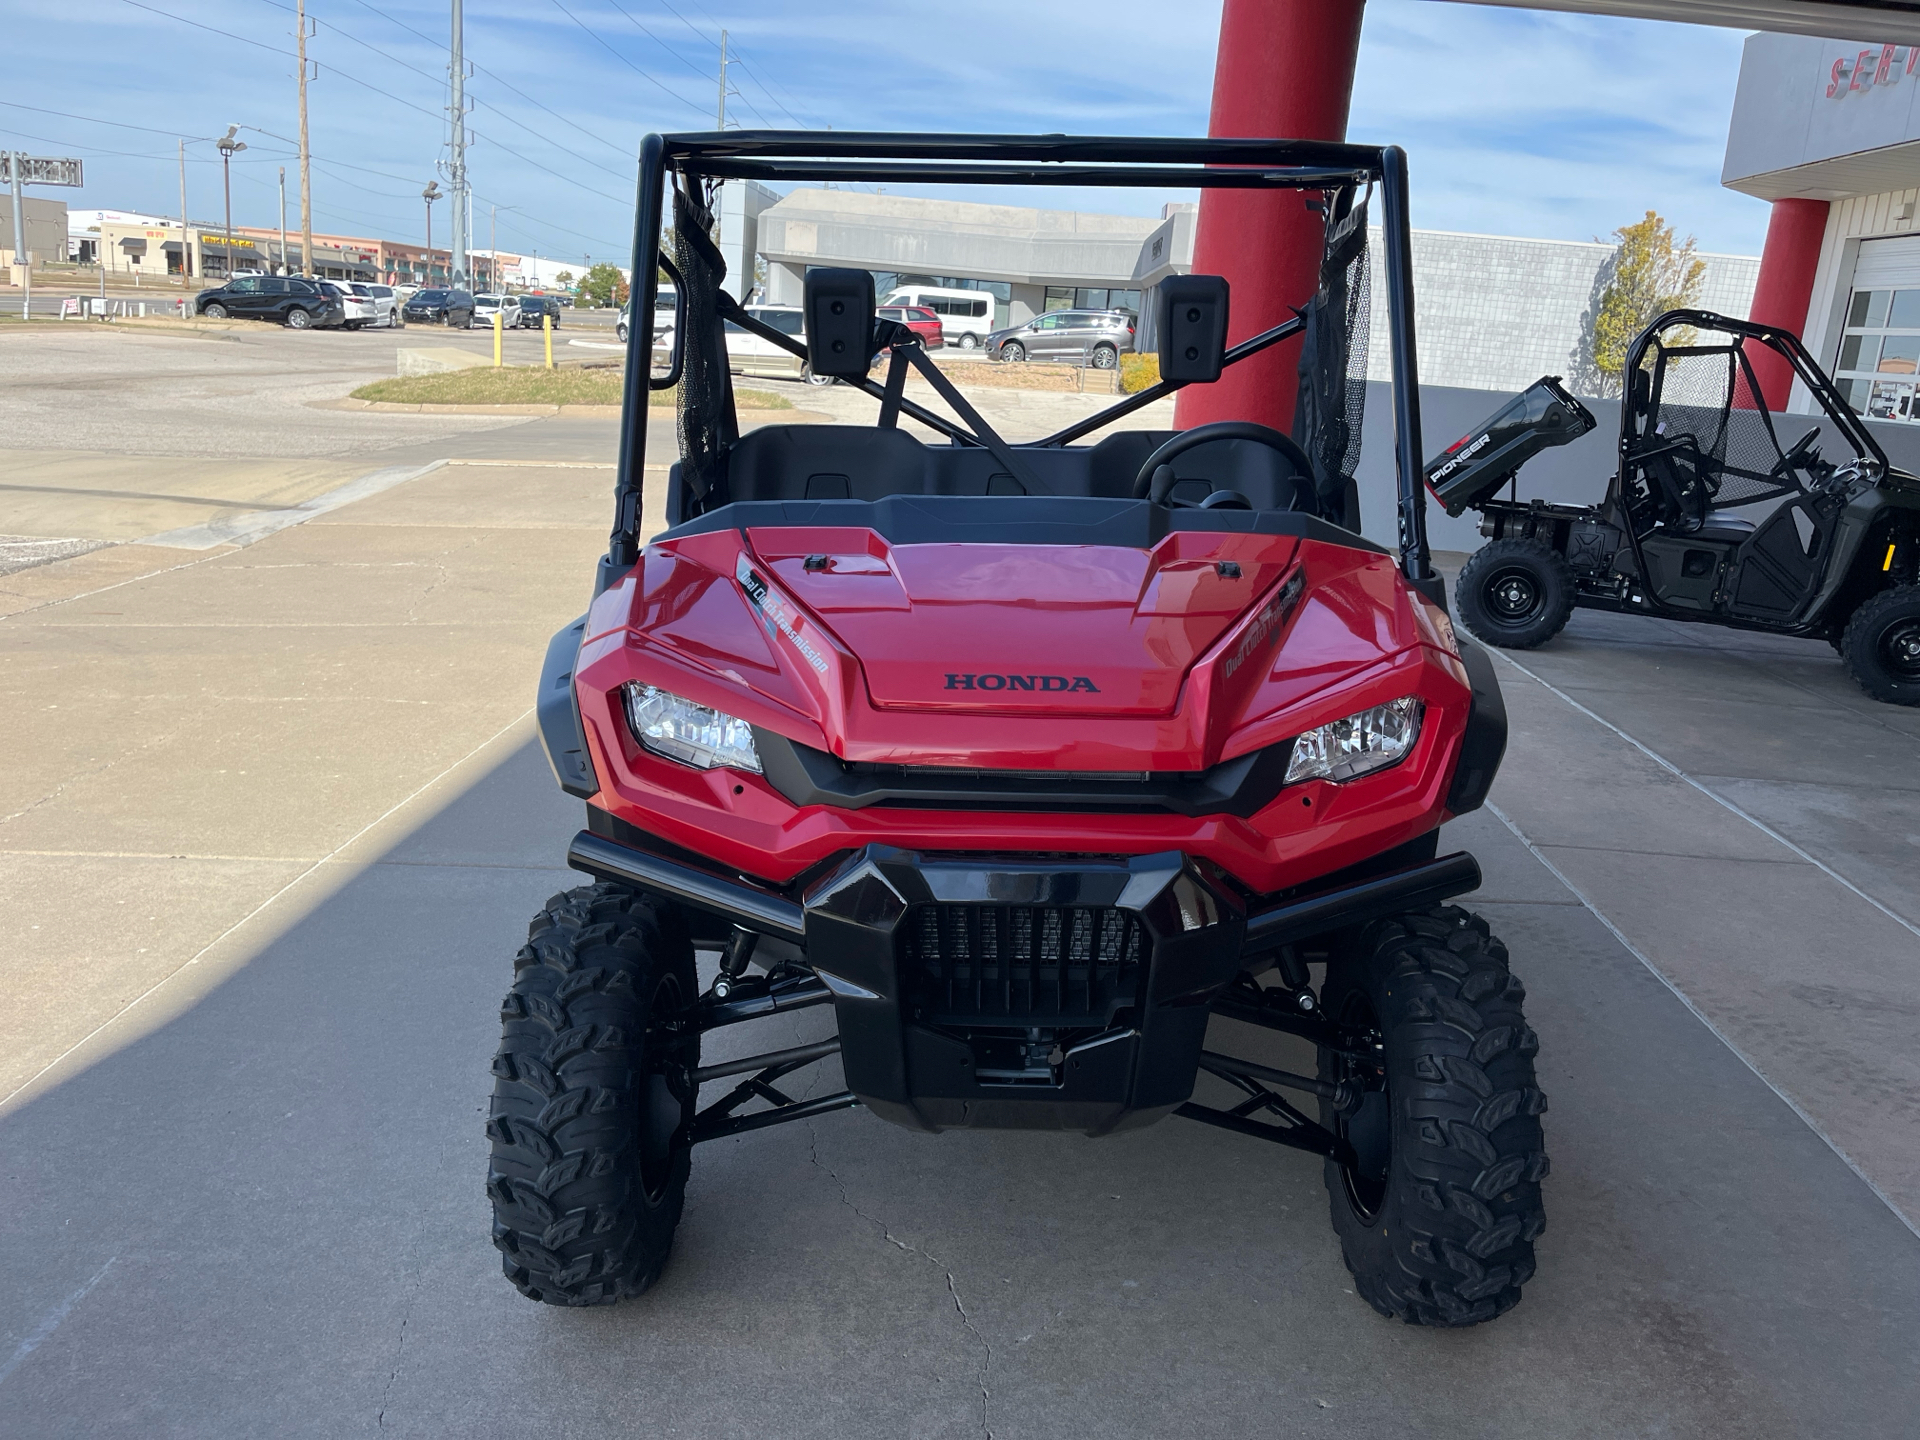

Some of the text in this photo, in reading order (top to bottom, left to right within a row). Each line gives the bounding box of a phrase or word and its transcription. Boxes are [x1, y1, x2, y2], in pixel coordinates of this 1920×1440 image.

[1430, 433, 1491, 483] PIONEER
[740, 570, 829, 673] Dual Clutch Transmission
[1226, 645, 1245, 679] Dual
[944, 674, 1101, 693] HONDA
